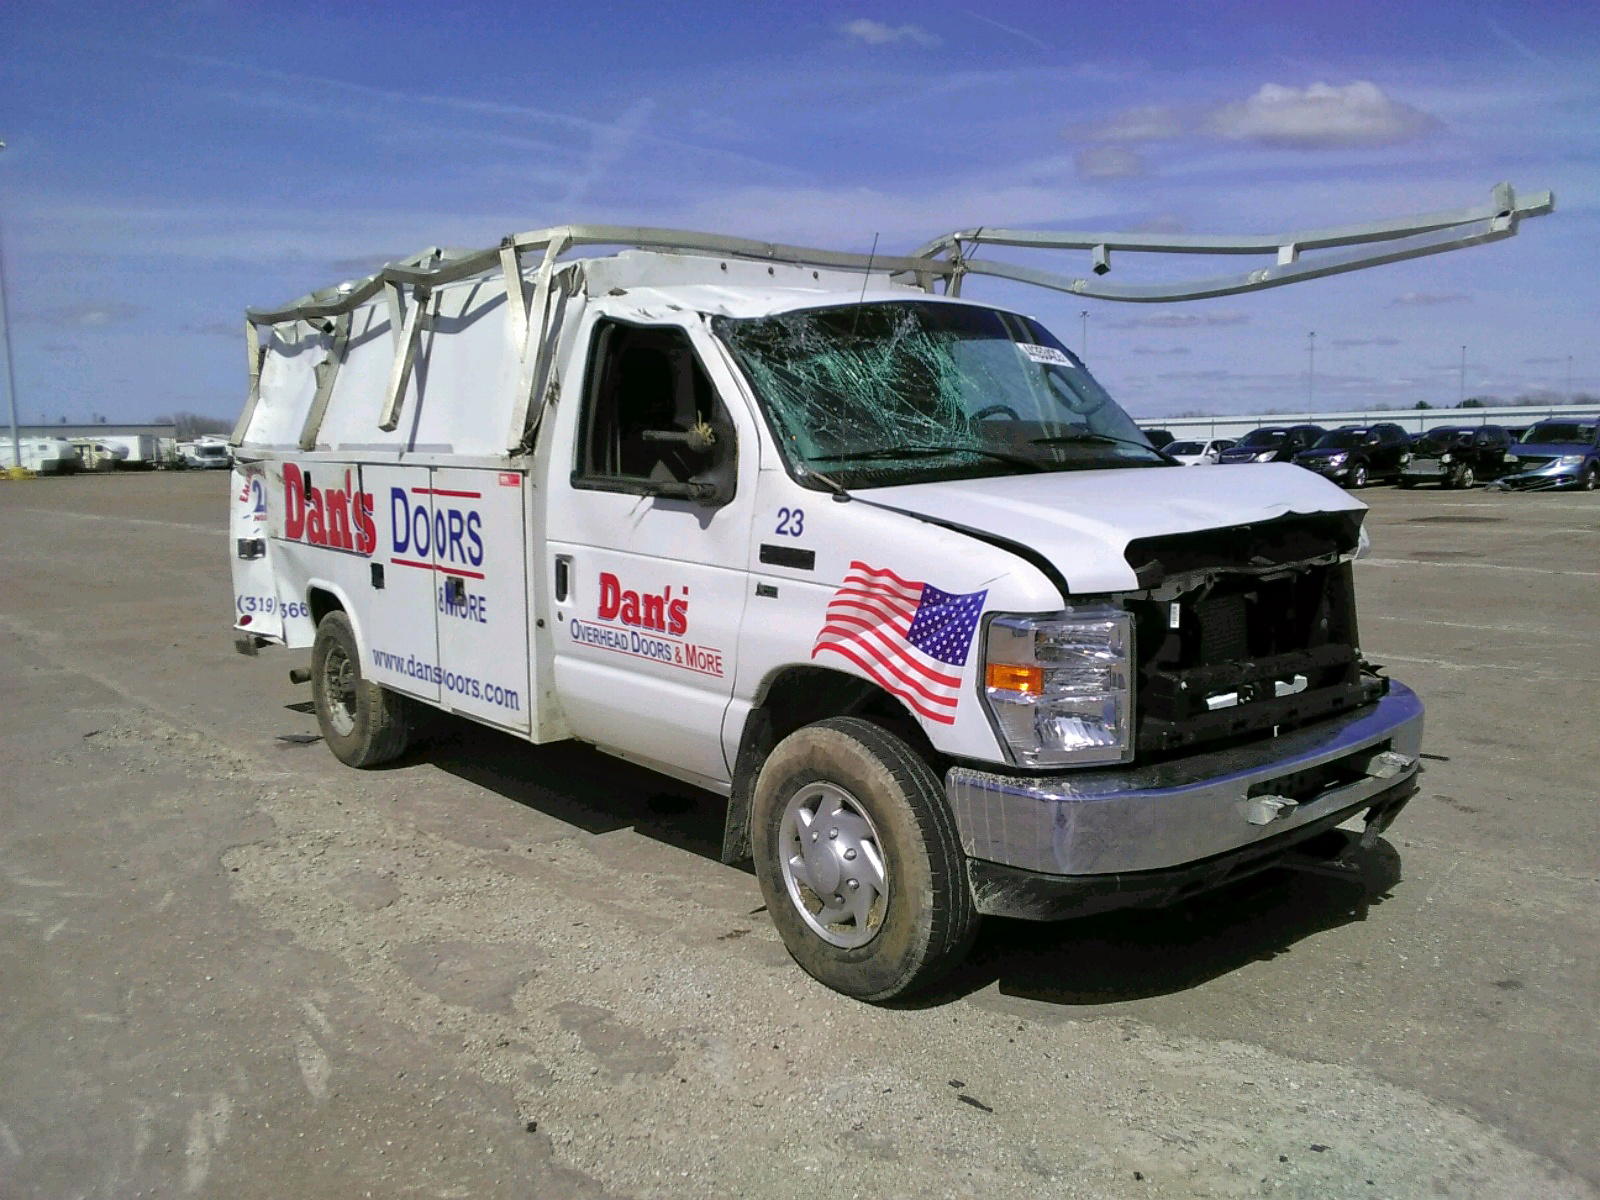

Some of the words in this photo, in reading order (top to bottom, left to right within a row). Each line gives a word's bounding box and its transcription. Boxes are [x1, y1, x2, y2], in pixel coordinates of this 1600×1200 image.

[283, 462, 377, 554] Dan's
[390, 487, 483, 566] DOORS
[775, 507, 805, 537] 23
[237, 595, 277, 613] (319)
[598, 572, 688, 636] Dan's
[571, 618, 628, 650] OVERHEAD
[631, 631, 671, 661] DOORS
[675, 646, 683, 664] &
[685, 643, 723, 674] MORE
